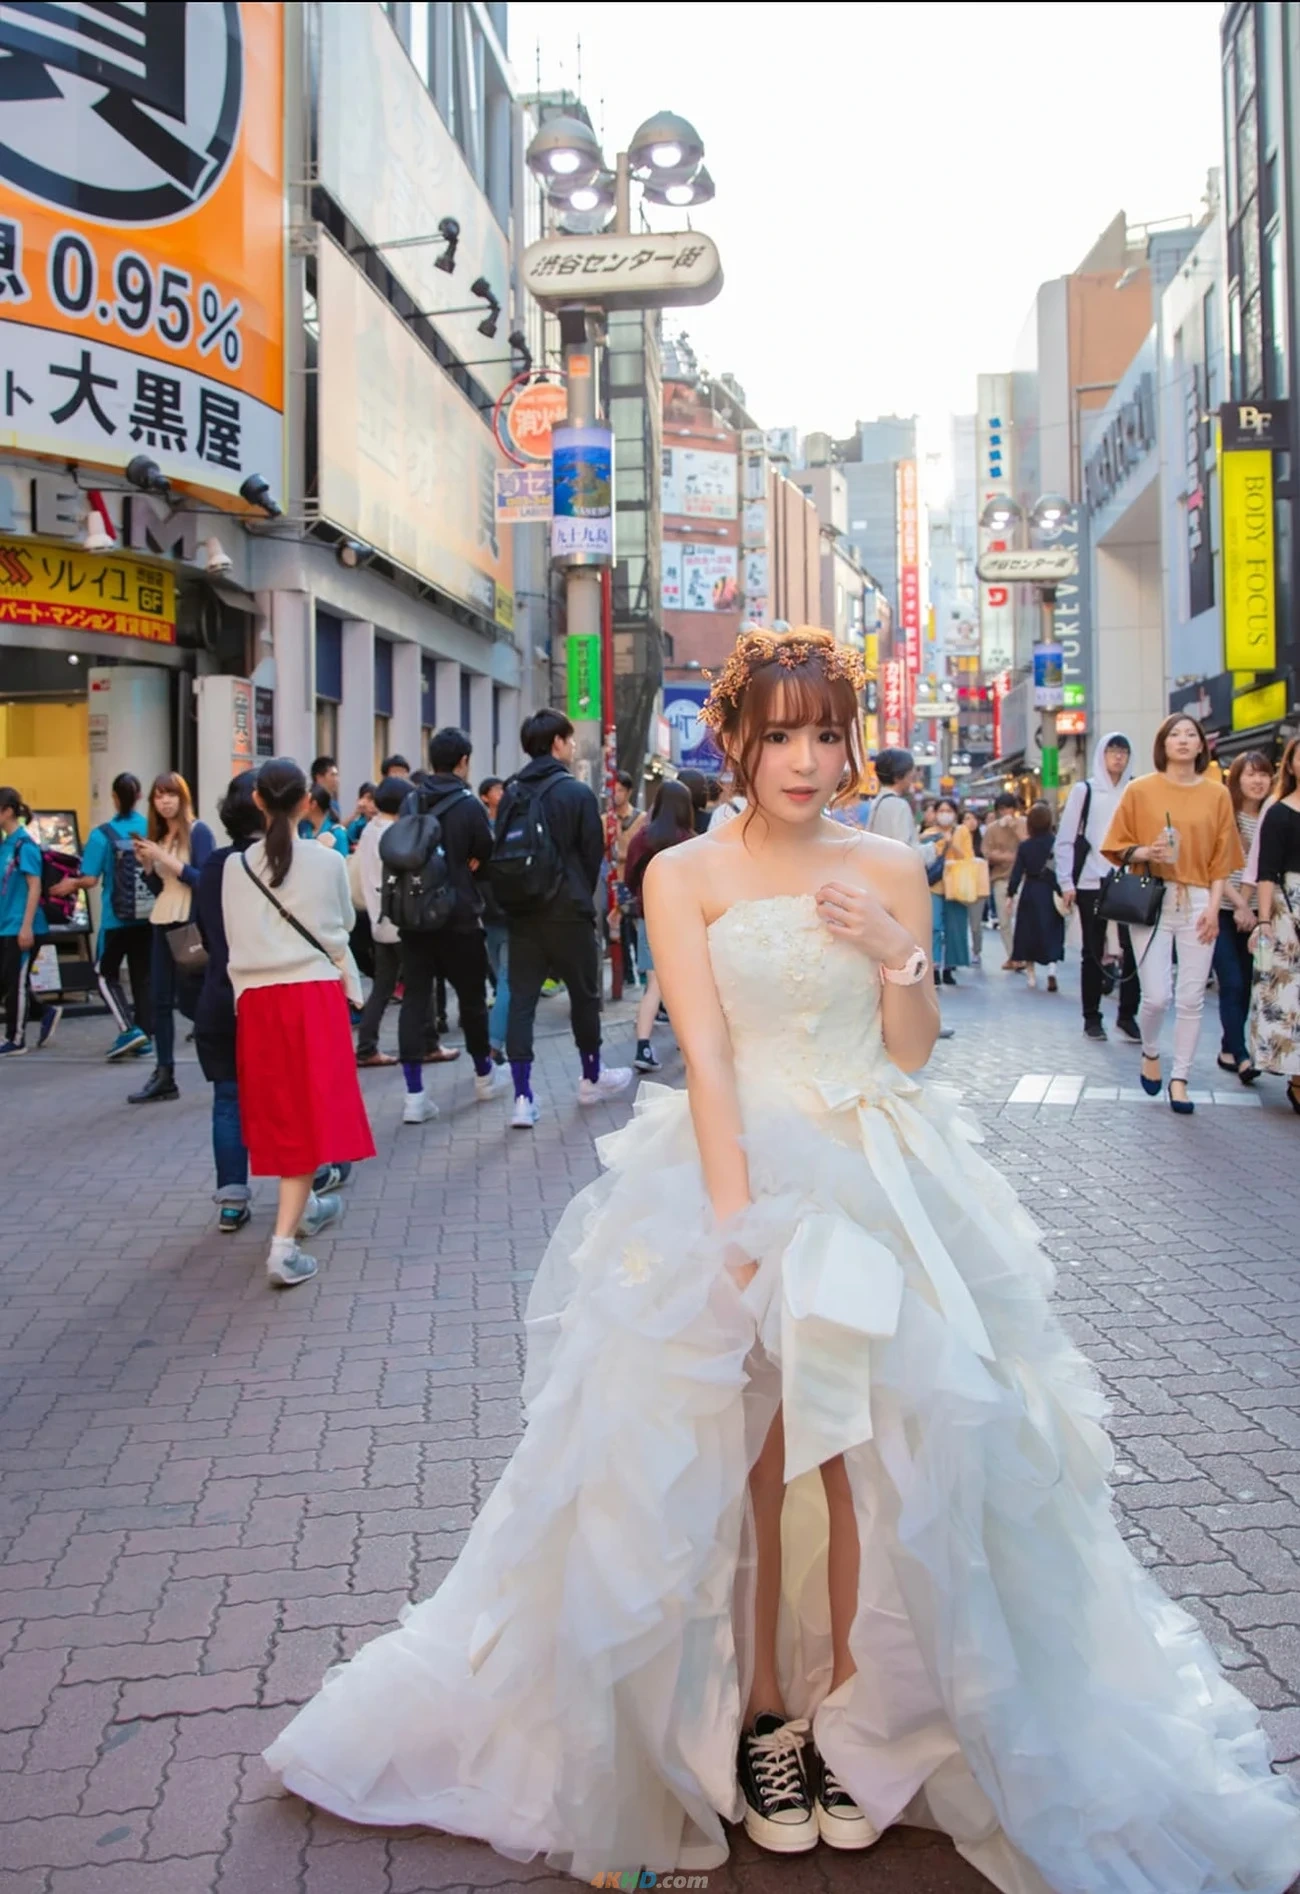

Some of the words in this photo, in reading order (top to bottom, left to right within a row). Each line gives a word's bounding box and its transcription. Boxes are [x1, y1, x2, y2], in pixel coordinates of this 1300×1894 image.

[530, 246, 707, 277] 渋谷センター街
[51, 234, 240, 365] 0.95%
[49, 350, 242, 473] 大黒屋
[1238, 405, 1272, 437] BF
[1244, 475, 1267, 544] BODY
[42, 557, 128, 603] ソレイユ
[1246, 558, 1268, 647] FOCUS
